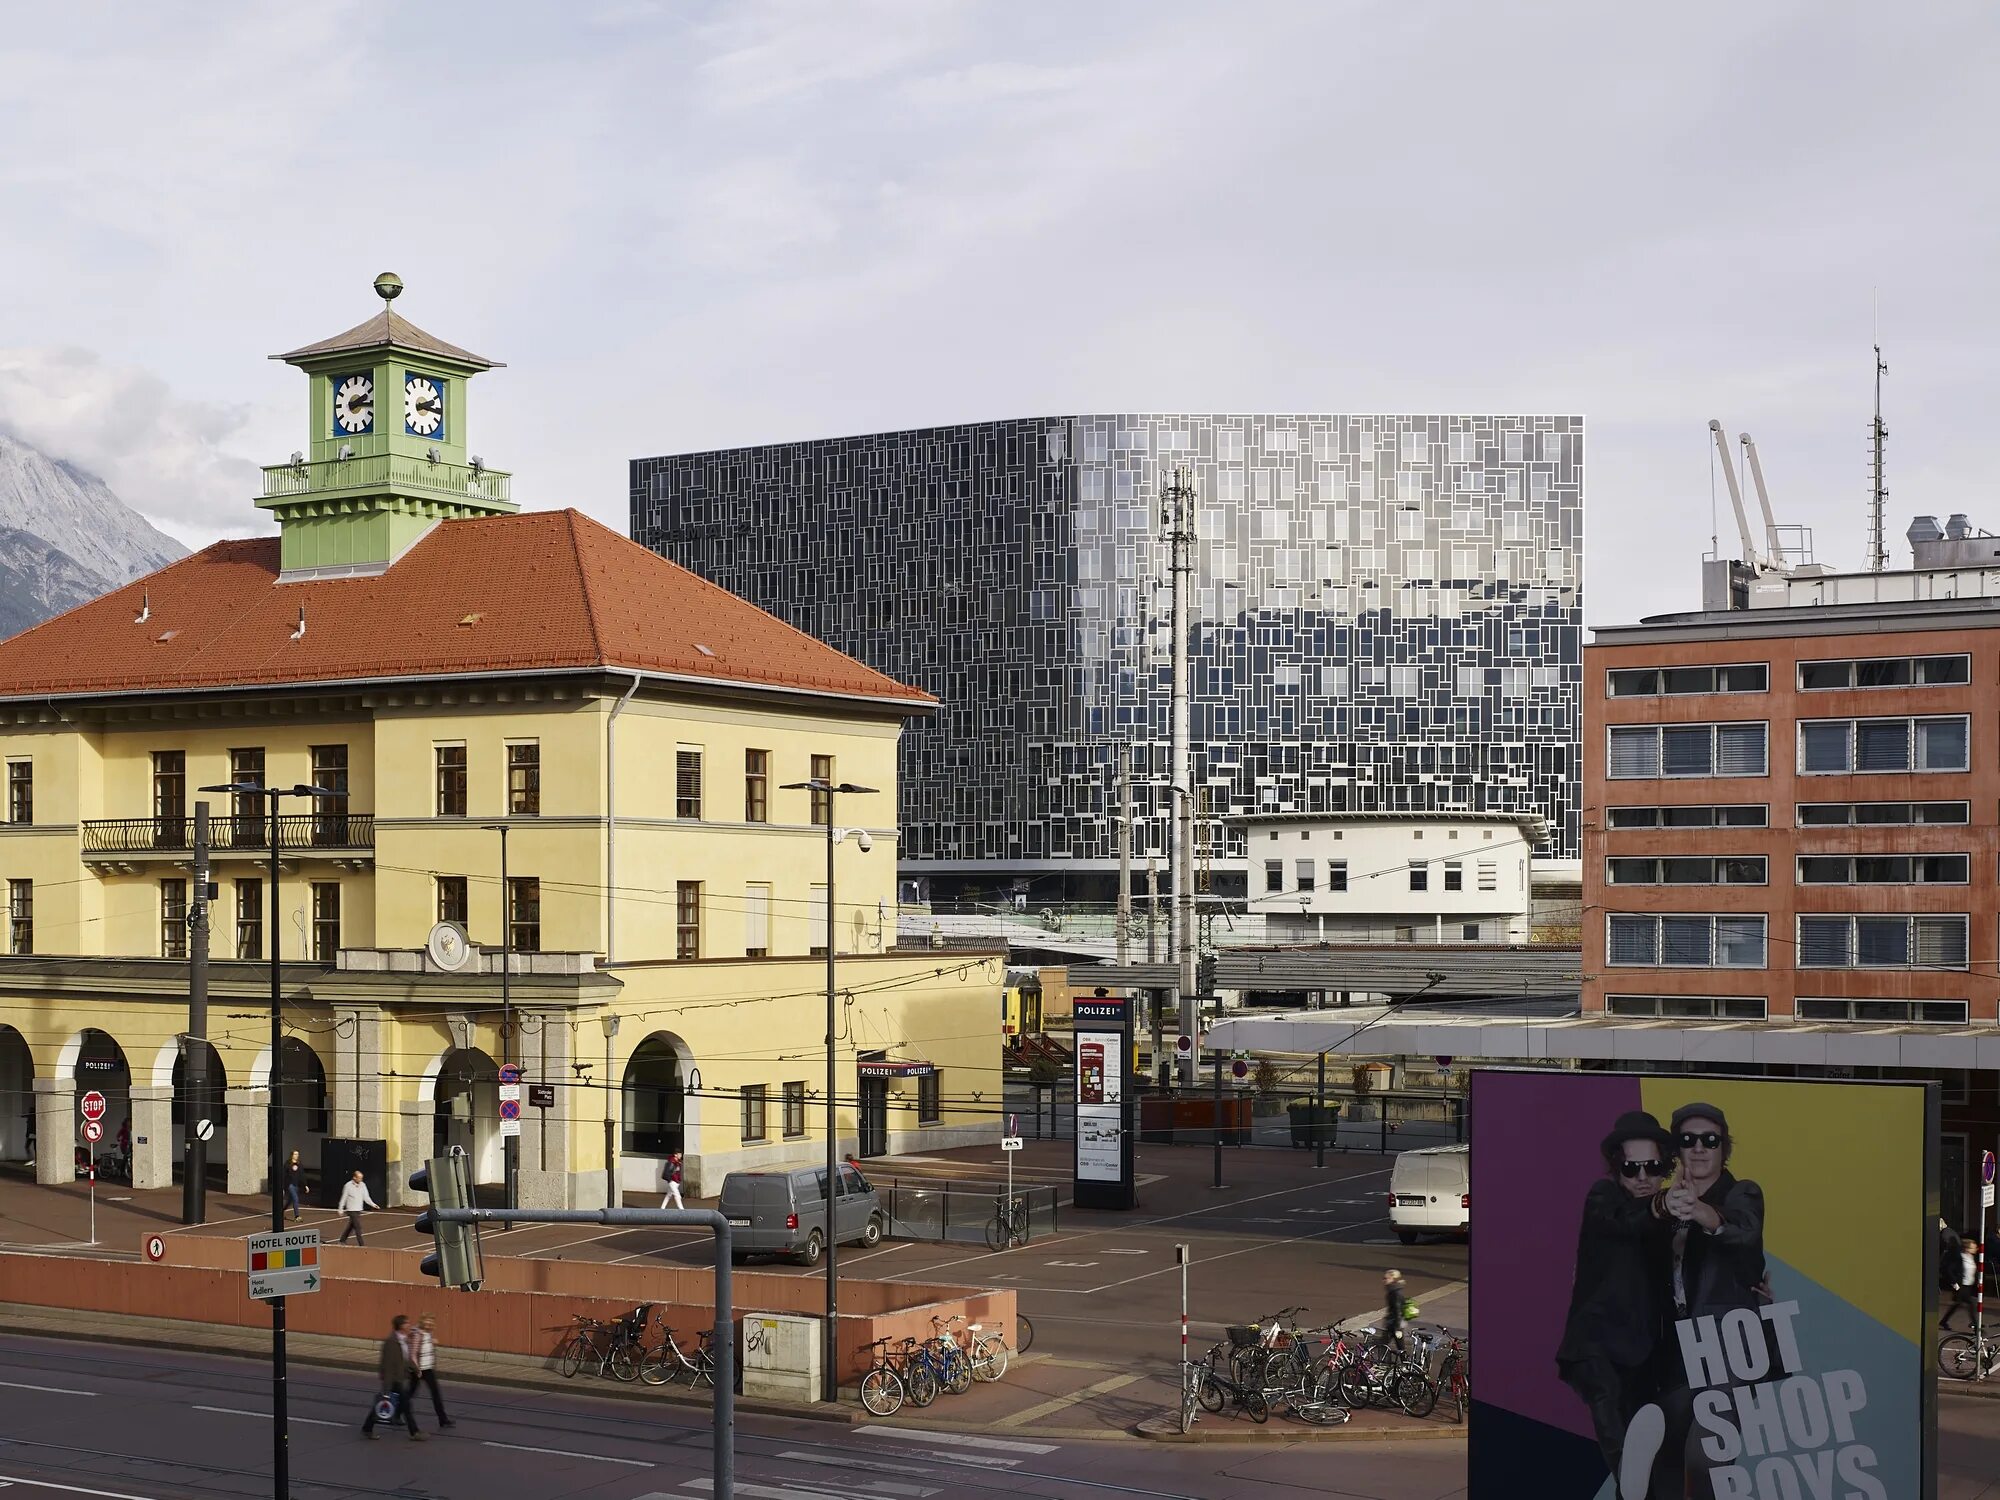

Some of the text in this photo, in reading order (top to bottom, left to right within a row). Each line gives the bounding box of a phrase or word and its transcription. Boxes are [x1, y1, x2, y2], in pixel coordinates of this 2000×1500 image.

[1078, 1006, 1115, 1015] POLIZEI
[85, 1062, 111, 1070] POLIZEI
[861, 1067, 892, 1075] POLIZEI
[907, 1067, 928, 1075] POLIZEI
[84, 1100, 103, 1112] STOP
[251, 1234, 317, 1250] HOTEL ROUTE
[252, 1287, 274, 1295] Adlers
[1674, 1300, 1803, 1389] HOT
[1692, 1369, 1867, 1462] SHOP
